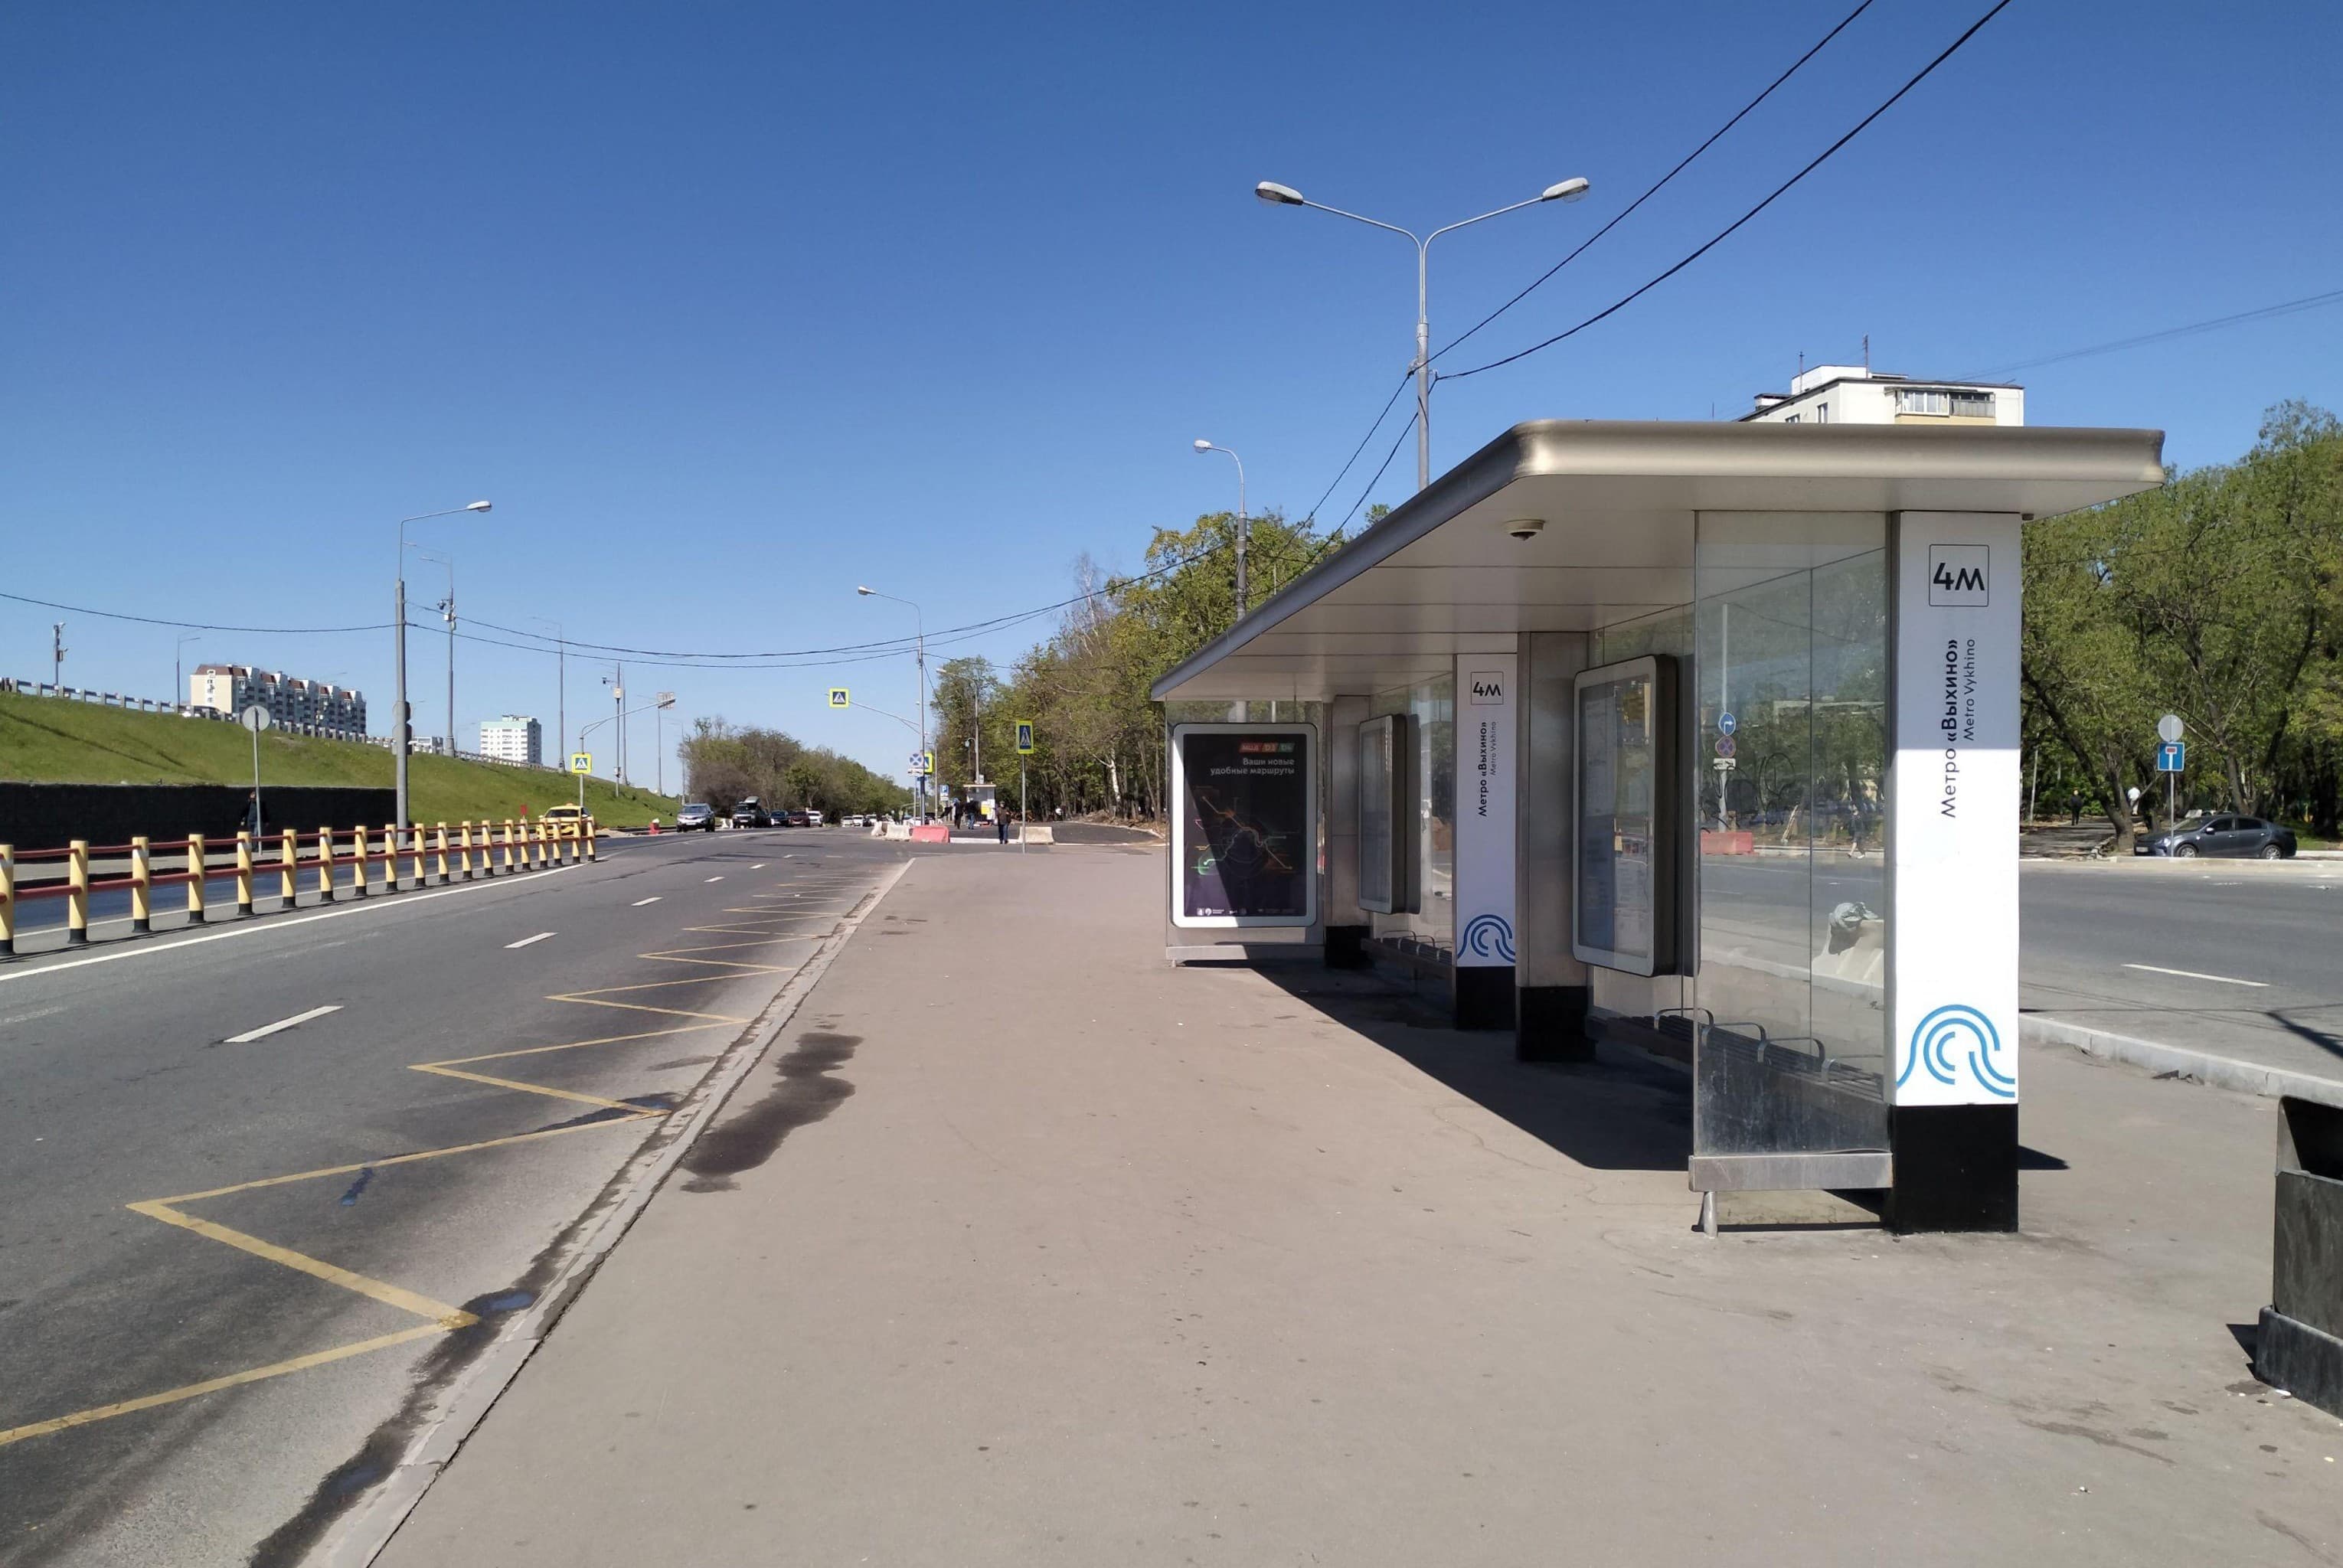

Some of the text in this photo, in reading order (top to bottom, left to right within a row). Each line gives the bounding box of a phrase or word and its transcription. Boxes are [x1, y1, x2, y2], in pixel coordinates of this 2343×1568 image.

[1933, 562, 1985, 591] 4М
[1472, 681, 1502, 697] 4М
[1963, 639, 1976, 741] Metro Vykhino
[1941, 639, 1960, 818] Метро «Выхино»
[1210, 766, 1294, 776] удобные маршруты
[1478, 721, 1488, 817] Метро «Выхино»
